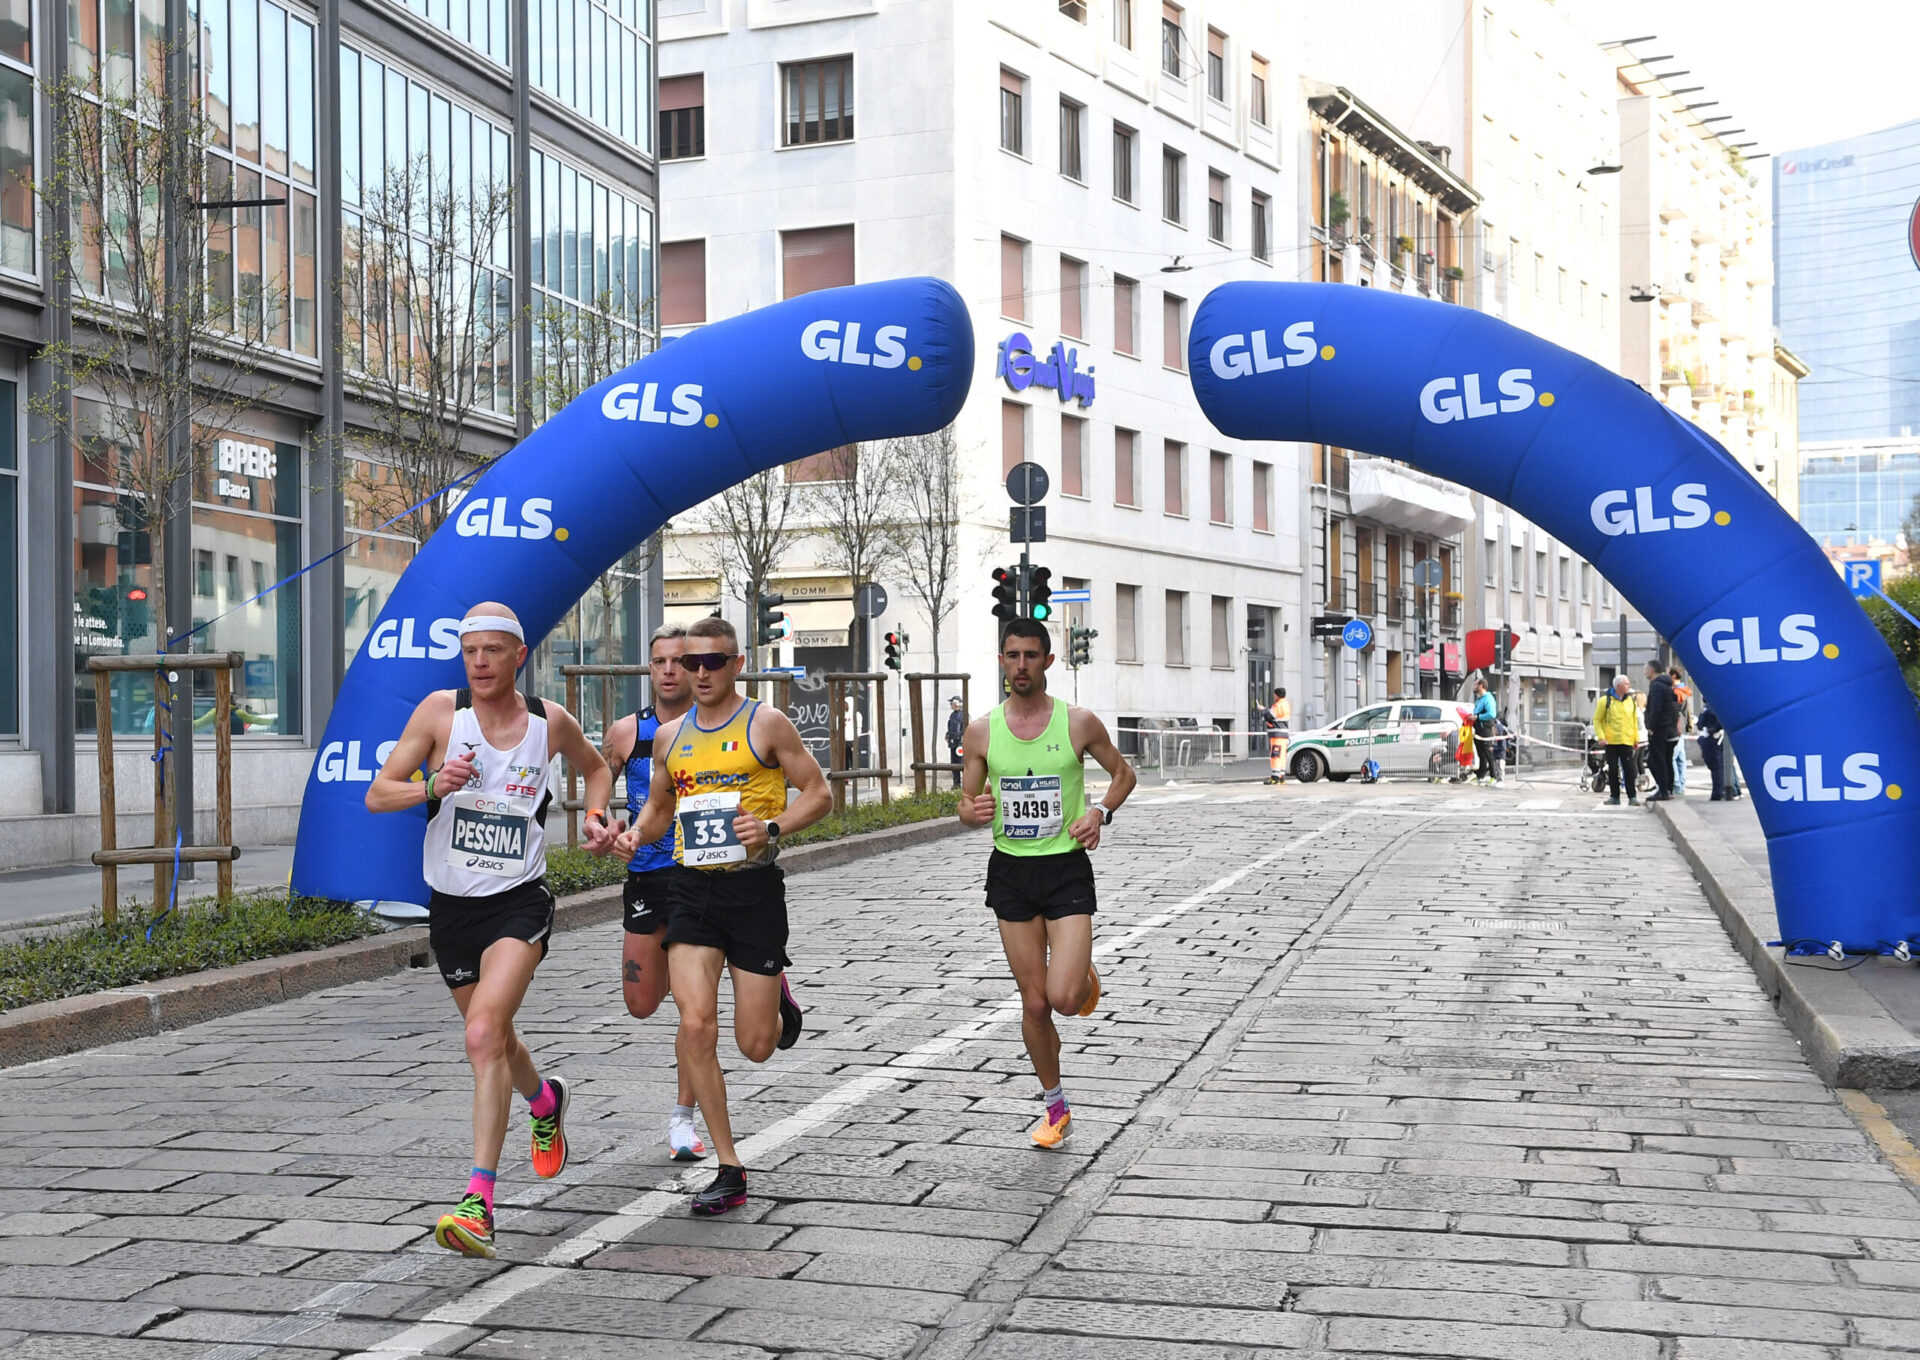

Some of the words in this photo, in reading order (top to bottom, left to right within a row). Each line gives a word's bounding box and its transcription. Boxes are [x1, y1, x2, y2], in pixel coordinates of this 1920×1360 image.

[219, 478, 250, 500] Banca
[1852, 563, 1873, 589] P
[793, 587, 827, 595] DOMM
[794, 637, 828, 645] DOMM
[505, 784, 537, 797] PTS
[1001, 780, 1023, 790] enel
[475, 799, 512, 814] enel
[693, 796, 721, 810] enel
[1012, 800, 1049, 819] 3439
[454, 818, 522, 856] PESSINA
[693, 818, 727, 846] 33
[1014, 827, 1035, 837] asics
[706, 850, 729, 861] asics
[478, 859, 505, 871] asics
